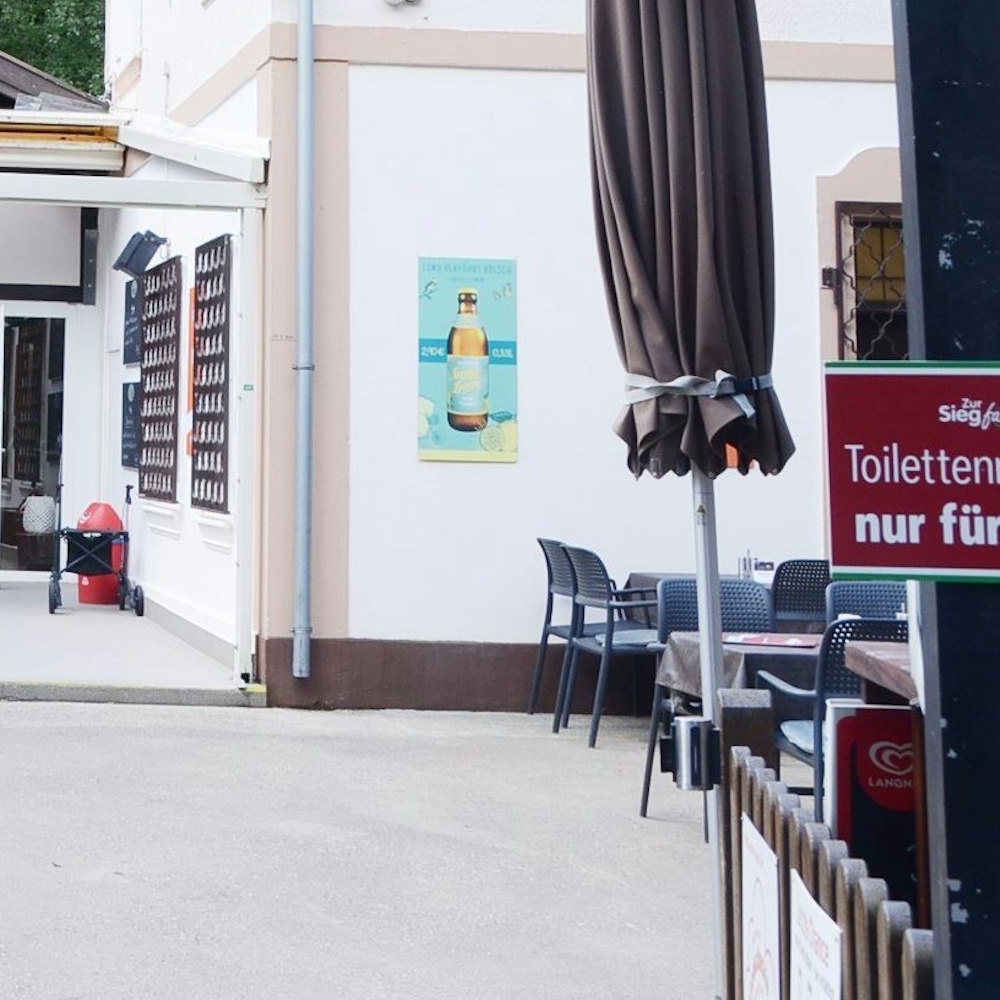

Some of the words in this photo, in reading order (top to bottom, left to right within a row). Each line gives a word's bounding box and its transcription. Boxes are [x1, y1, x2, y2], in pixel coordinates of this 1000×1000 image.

[961, 397, 983, 409] Zur
[855, 512, 925, 544] nur
[940, 502, 1000, 545] für
